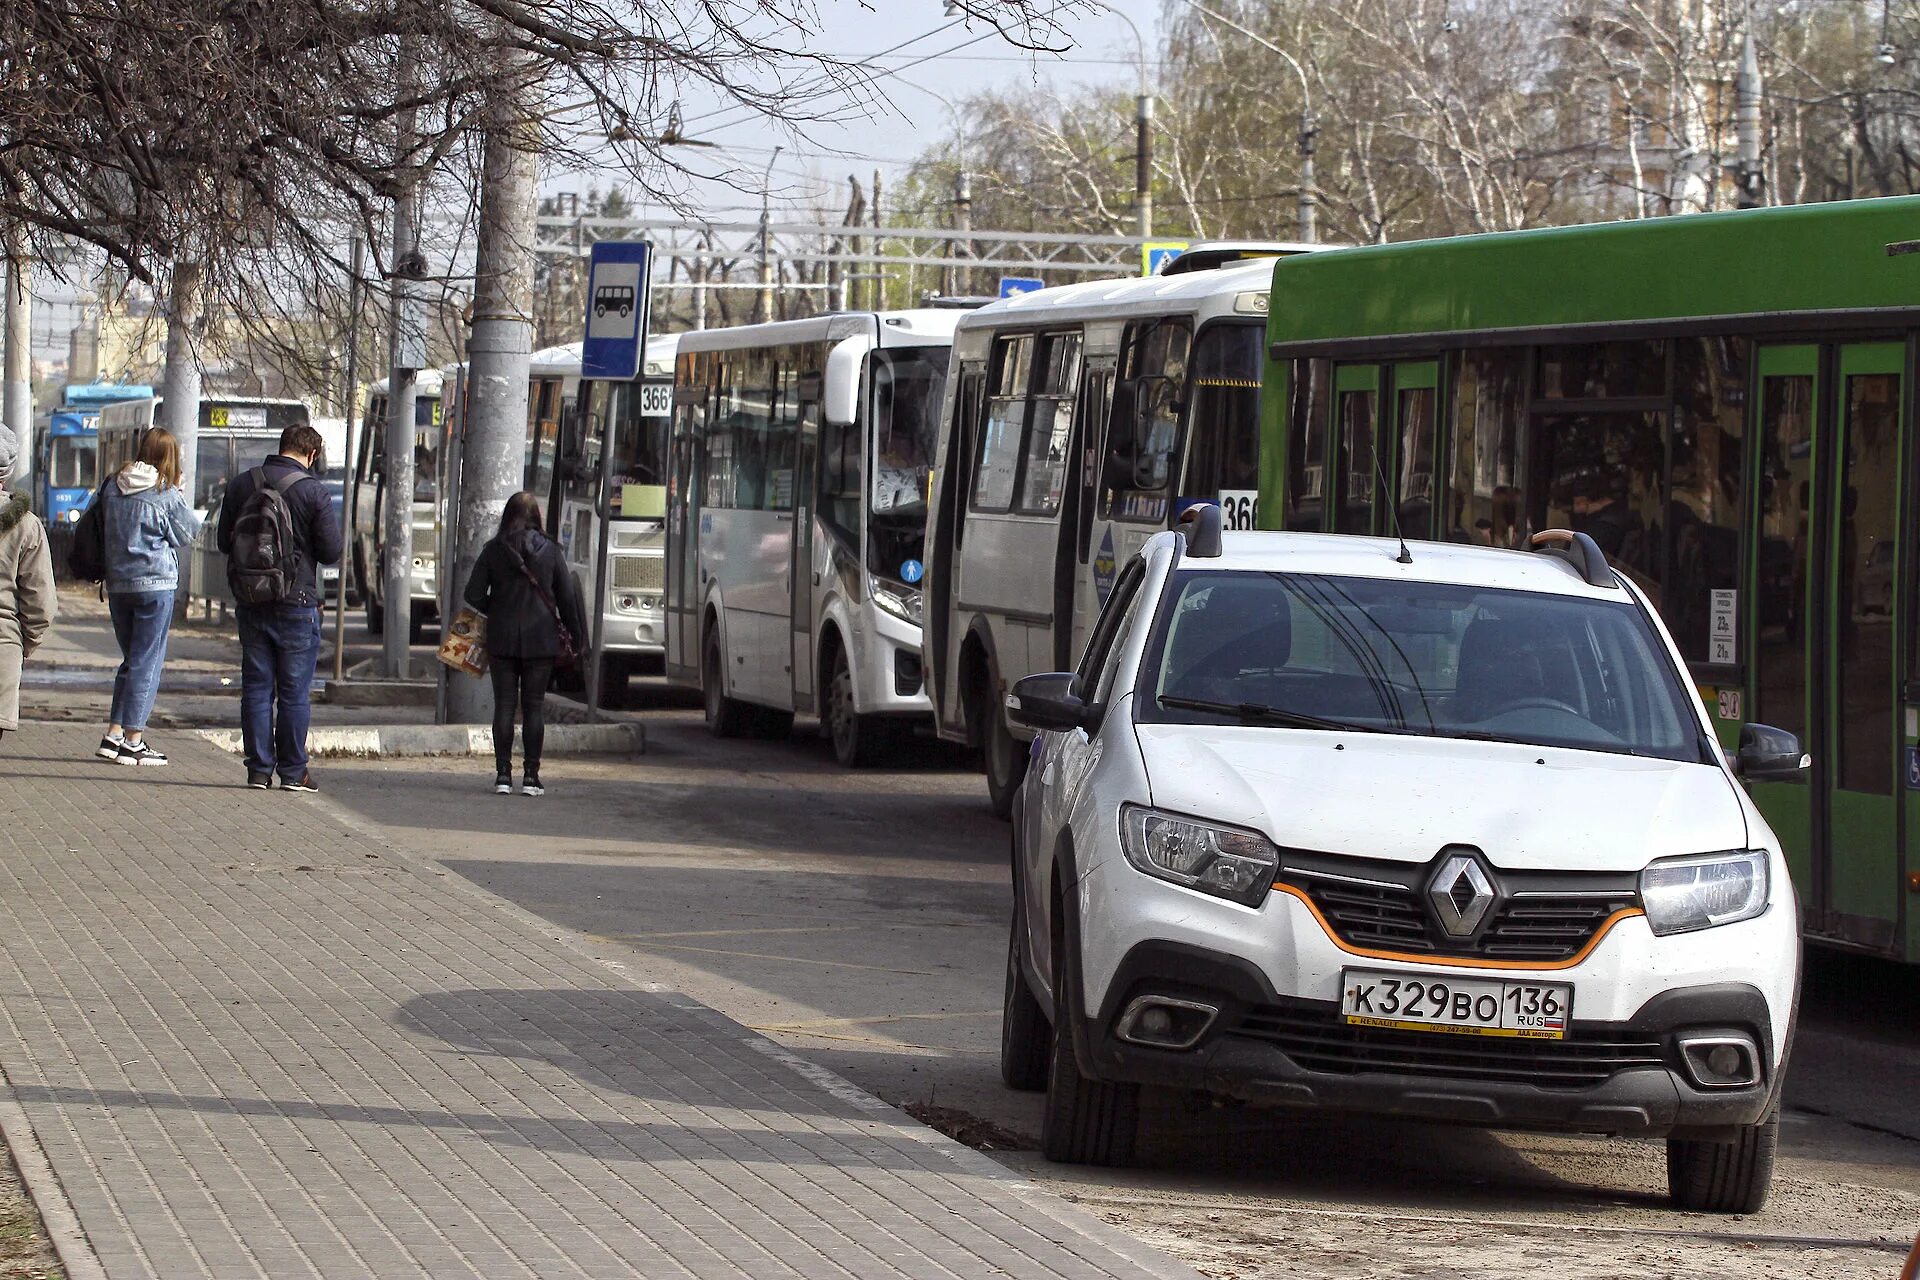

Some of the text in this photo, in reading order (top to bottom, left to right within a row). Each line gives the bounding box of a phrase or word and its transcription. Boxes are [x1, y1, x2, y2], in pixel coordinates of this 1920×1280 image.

[1507, 986, 1559, 1016] 136
[1360, 1018, 1399, 1028] RENAULT
[1517, 1015, 1544, 1026] RUS
[1430, 1024, 1446, 1032] (473)
